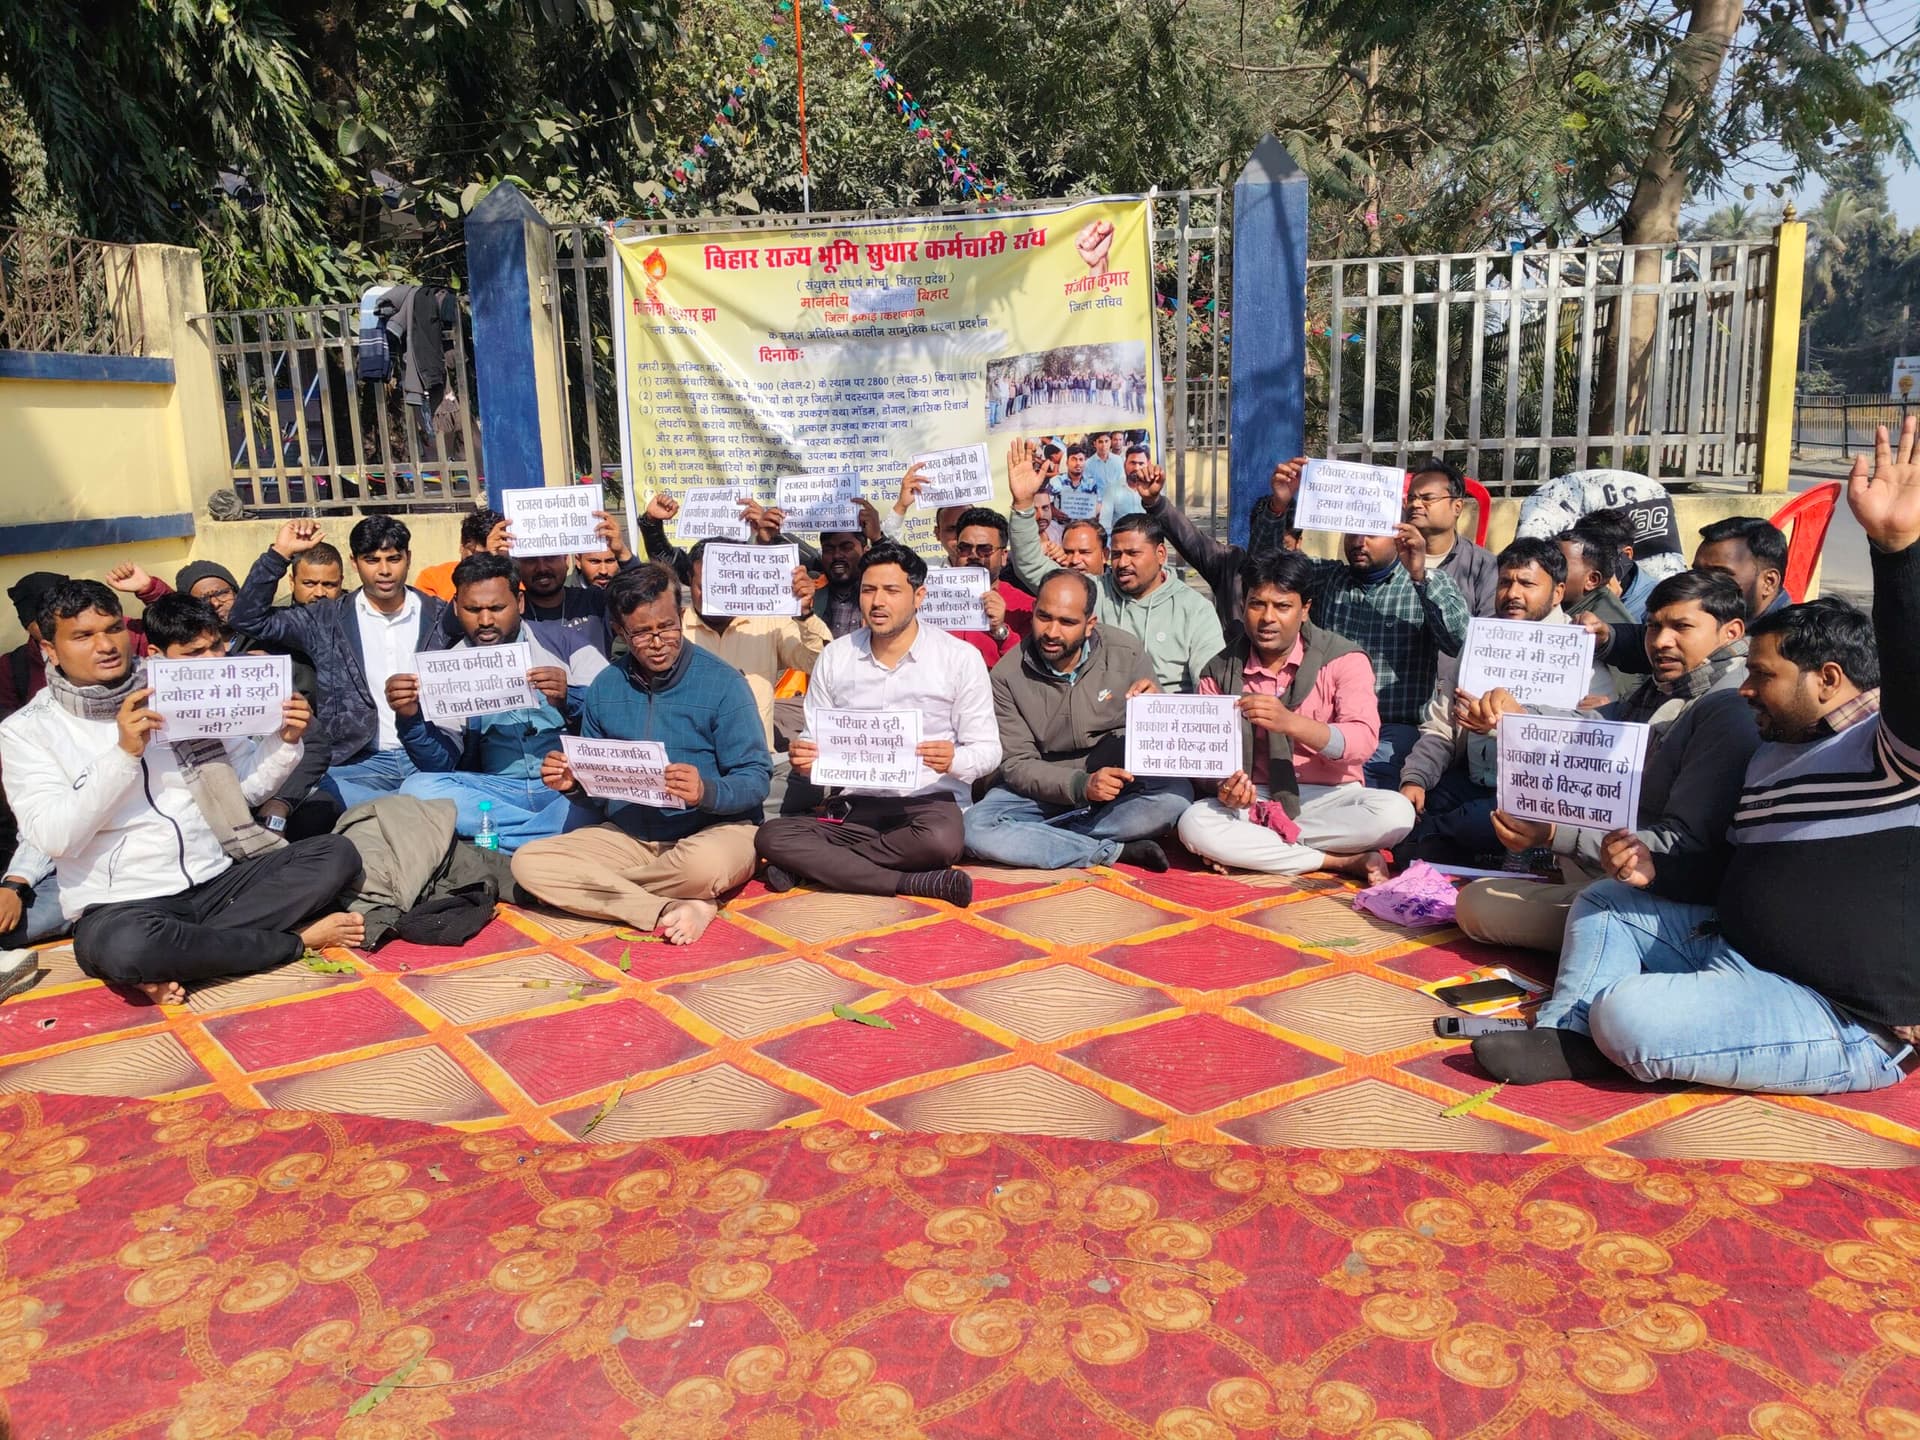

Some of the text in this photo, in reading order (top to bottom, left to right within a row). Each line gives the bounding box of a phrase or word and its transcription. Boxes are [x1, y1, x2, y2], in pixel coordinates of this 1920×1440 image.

[704, 245, 759, 270] बिहार
[765, 247, 812, 268] राज्य
[818, 239, 860, 273] भूमि
[865, 242, 918, 271] सुधार
[924, 231, 1007, 260] कर्मचारी
[1013, 228, 1047, 250] संघ
[805, 280, 835, 292] संयुक्त
[896, 276, 921, 285] बिहार
[925, 272, 946, 284] प्रदेश
[1064, 272, 1129, 295] संजीत कुमार
[800, 292, 849, 308] माननीय
[918, 288, 949, 302] बिहार
[1069, 295, 1122, 313] जिला सचिव
[702, 308, 716, 323] झा
[825, 312, 848, 323] जिला
[852, 326, 885, 337] कालीन
[931, 322, 955, 333] धरना
[959, 315, 988, 331] प्रदर्शन
[818, 378, 826, 388] के
[829, 379, 851, 388] स्थान
[854, 379, 865, 387] पर
[867, 378, 889, 386] 2800
[935, 372, 957, 382] किया
[959, 372, 977, 380] जाय
[811, 392, 832, 404] जिला
[908, 388, 929, 398] किया
[932, 389, 950, 398] जाय
[912, 402, 942, 412] मासिक
[578, 493, 589, 508] को
[539, 514, 558, 529] जिला
[1345, 515, 1364, 528] दिया
[1368, 520, 1387, 530] जाय
[560, 532, 579, 547] किया
[754, 554, 789, 564] पर डाका
[718, 568, 744, 579] डालना
[740, 584, 779, 595] अधिकारों
[724, 601, 753, 611] सम्मान
[1529, 629, 1542, 644] भी
[1474, 644, 1512, 660] त्योहार
[1516, 648, 1525, 662] में
[1530, 649, 1545, 663] भी
[426, 650, 516, 673] राजस्व कर्मचारी से
[220, 664, 236, 679] भी
[1484, 666, 1565, 685] क्या हम इंसान
[161, 686, 205, 702] त्योहार
[209, 684, 220, 699] में
[226, 684, 241, 698] भी
[427, 674, 524, 697] कार्यालय अवधि तक
[176, 703, 265, 720] क्या हम इंसान
[435, 694, 524, 714] ही कार्य लिया जाय
[871, 716, 880, 730] से
[1135, 721, 1168, 732] अवकाश
[1181, 722, 1220, 734] राज्यपाल
[1223, 721, 1232, 734] के
[830, 733, 867, 746] काम की
[1520, 723, 1614, 749] रविवार/राजपत्रित
[1138, 737, 1228, 752] आदेश के कार्य
[841, 750, 895, 765] गृह जिला में
[1143, 755, 1223, 771] लेना बंद किया जाय
[1506, 749, 1630, 775] अवकाश में राज्यपाल के
[650, 768, 664, 776] पर
[820, 767, 876, 782] पदस्थापन है
[1510, 770, 1622, 800] आदेश के कार्य
[631, 787, 650, 799] दिया
[1516, 793, 1612, 824] लेना बंद किया जाय
